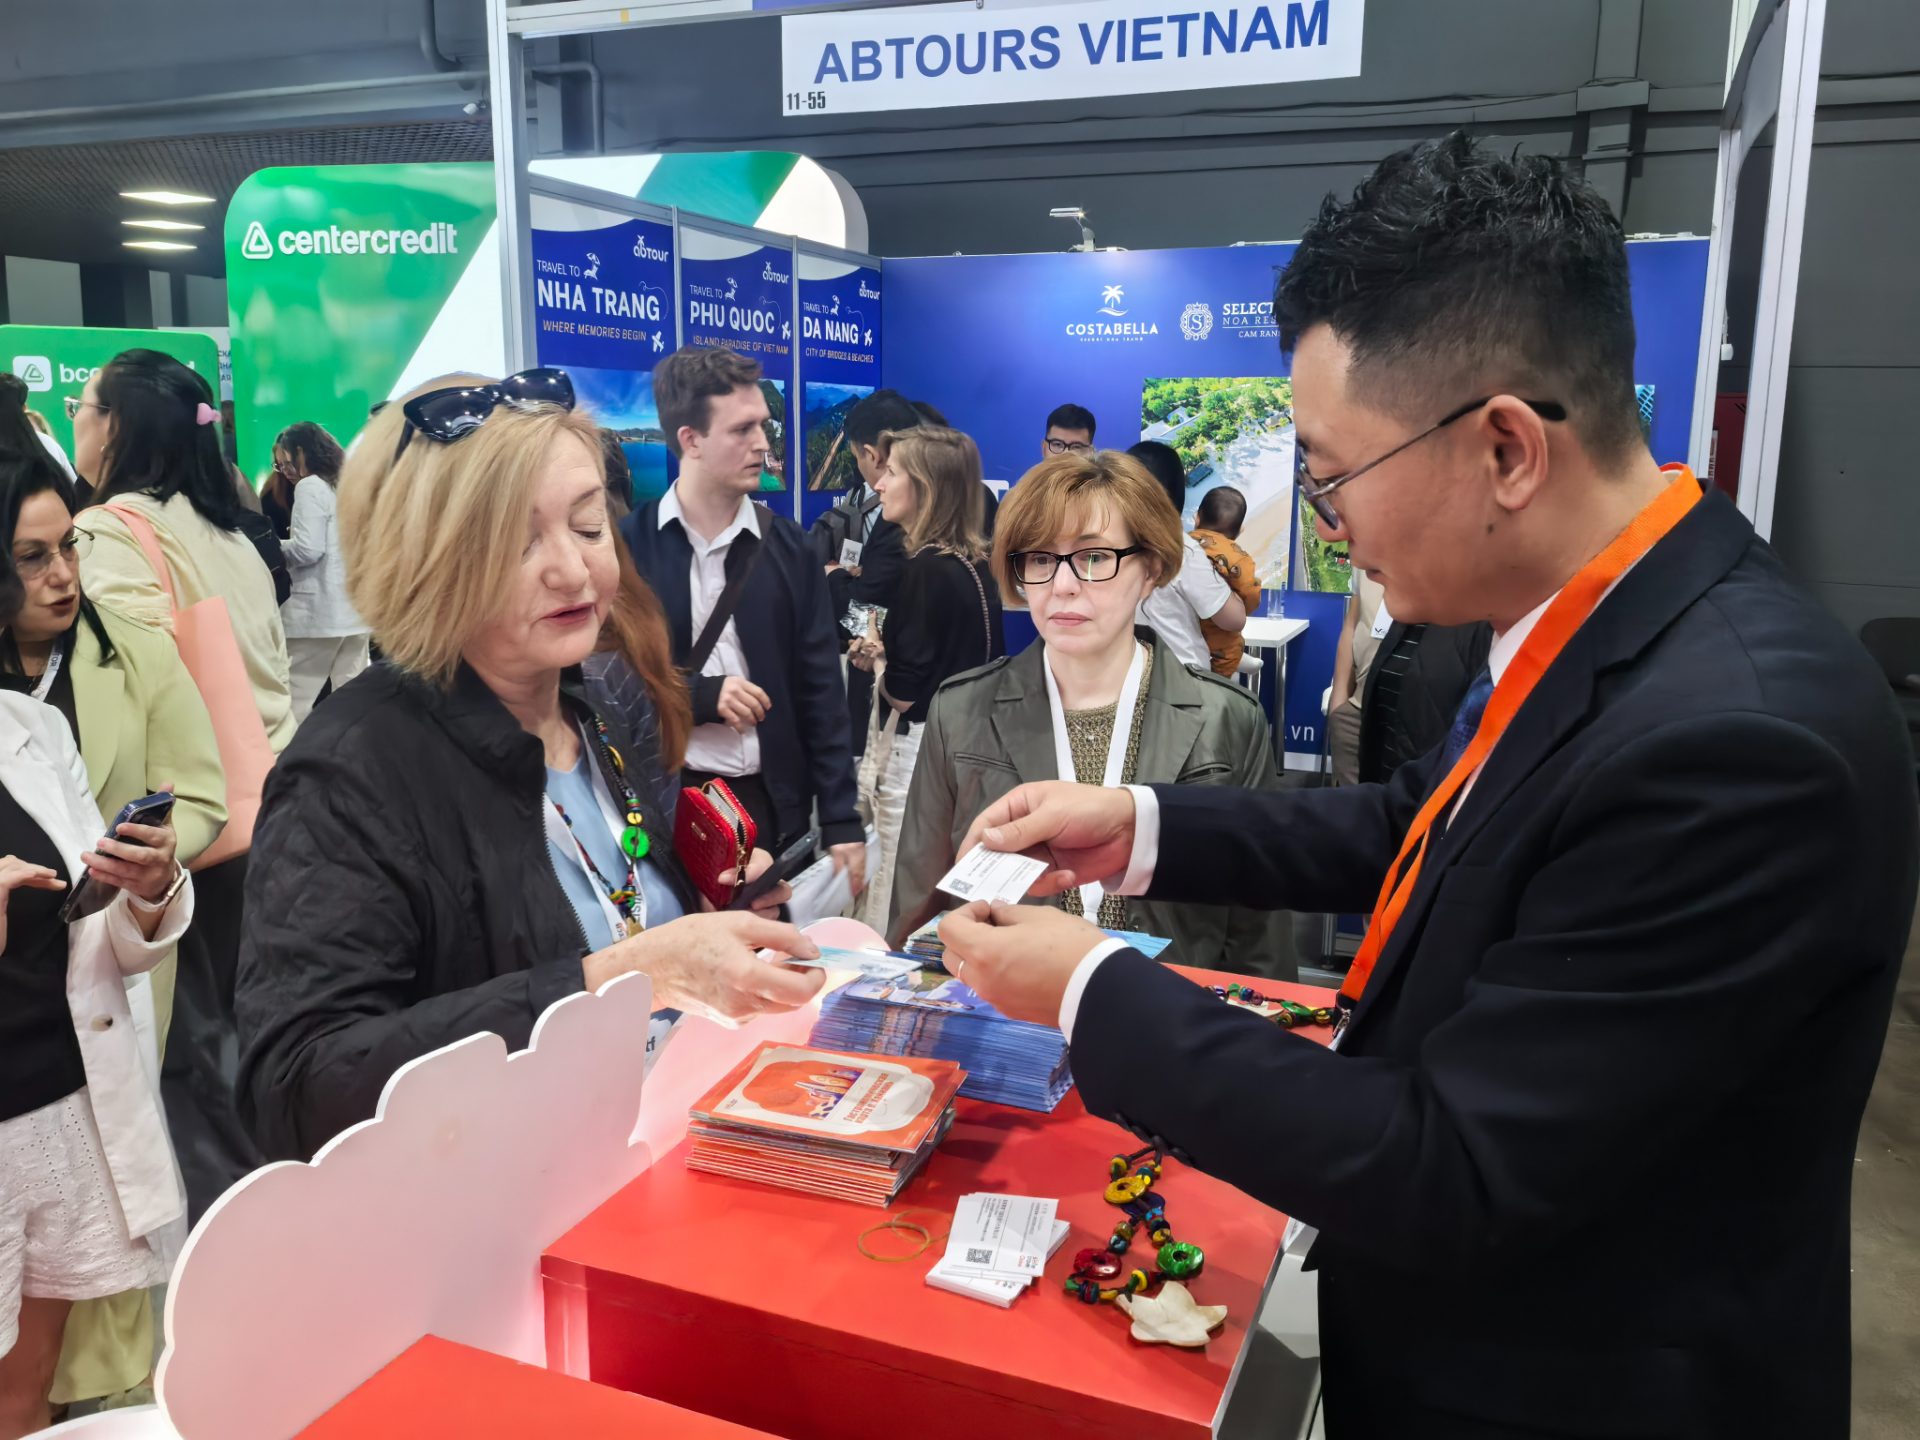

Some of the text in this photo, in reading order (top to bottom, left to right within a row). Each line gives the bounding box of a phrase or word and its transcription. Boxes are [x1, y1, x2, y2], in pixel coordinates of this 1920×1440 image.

[813, 0, 1330, 84] ABTOURS VIETNAM
[786, 91, 826, 110] 11-55
[278, 222, 458, 255] centercredit
[536, 259, 581, 277] TRAVEL TO
[537, 278, 660, 321] NHA TRANG
[690, 284, 723, 299] TRAVEL TO
[803, 301, 829, 314] TRAVEL TO
[690, 300, 775, 334] PHU QUOC
[1222, 316, 1249, 326] NOA
[543, 319, 647, 341] WHERE MEMORIES BEGIN
[803, 316, 859, 345] DA NANG
[1065, 322, 1159, 336] COSTABELLA
[1238, 329, 1280, 338] CAM RAN
[693, 335, 719, 347] ISLAND
[752, 341, 761, 352] OF
[805, 347, 818, 357] CITY
